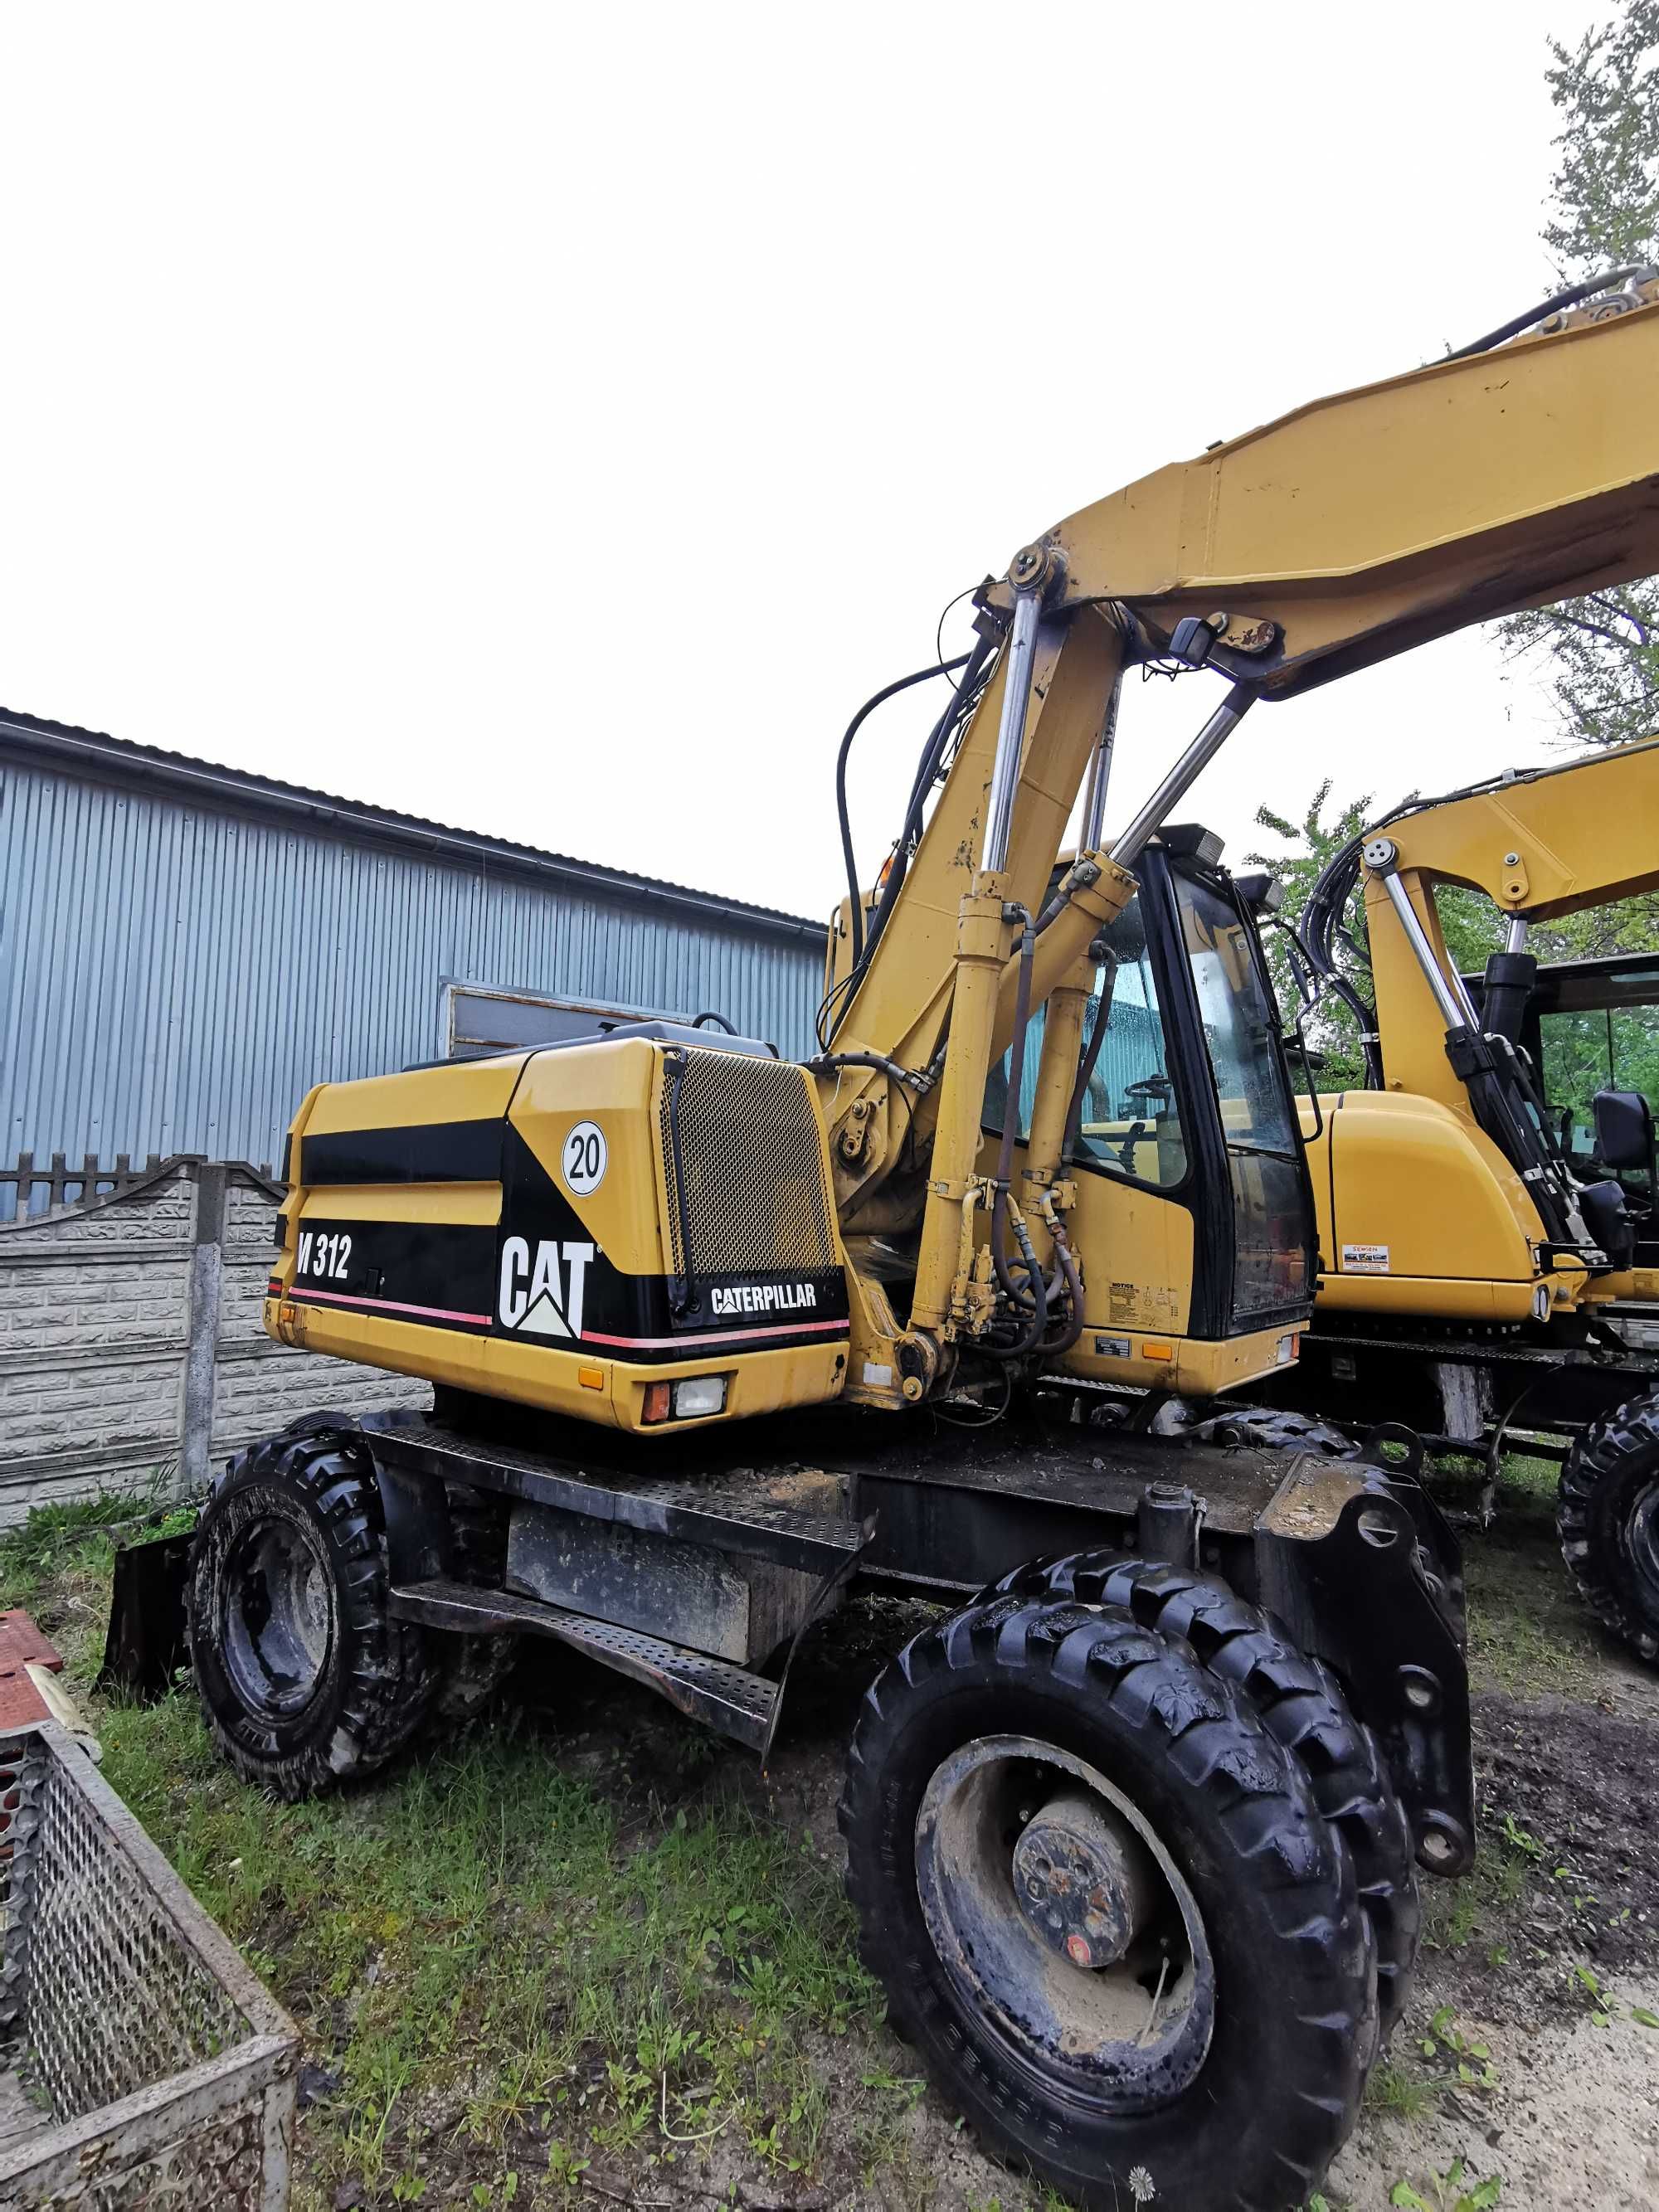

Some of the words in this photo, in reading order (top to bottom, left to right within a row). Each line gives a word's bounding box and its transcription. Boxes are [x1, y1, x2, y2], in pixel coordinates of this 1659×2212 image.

[569, 1133, 600, 1179] 20
[313, 1233, 353, 1279] 312
[499, 1236, 594, 1339] CAT
[711, 1283, 817, 1315] CATERPILLAR
